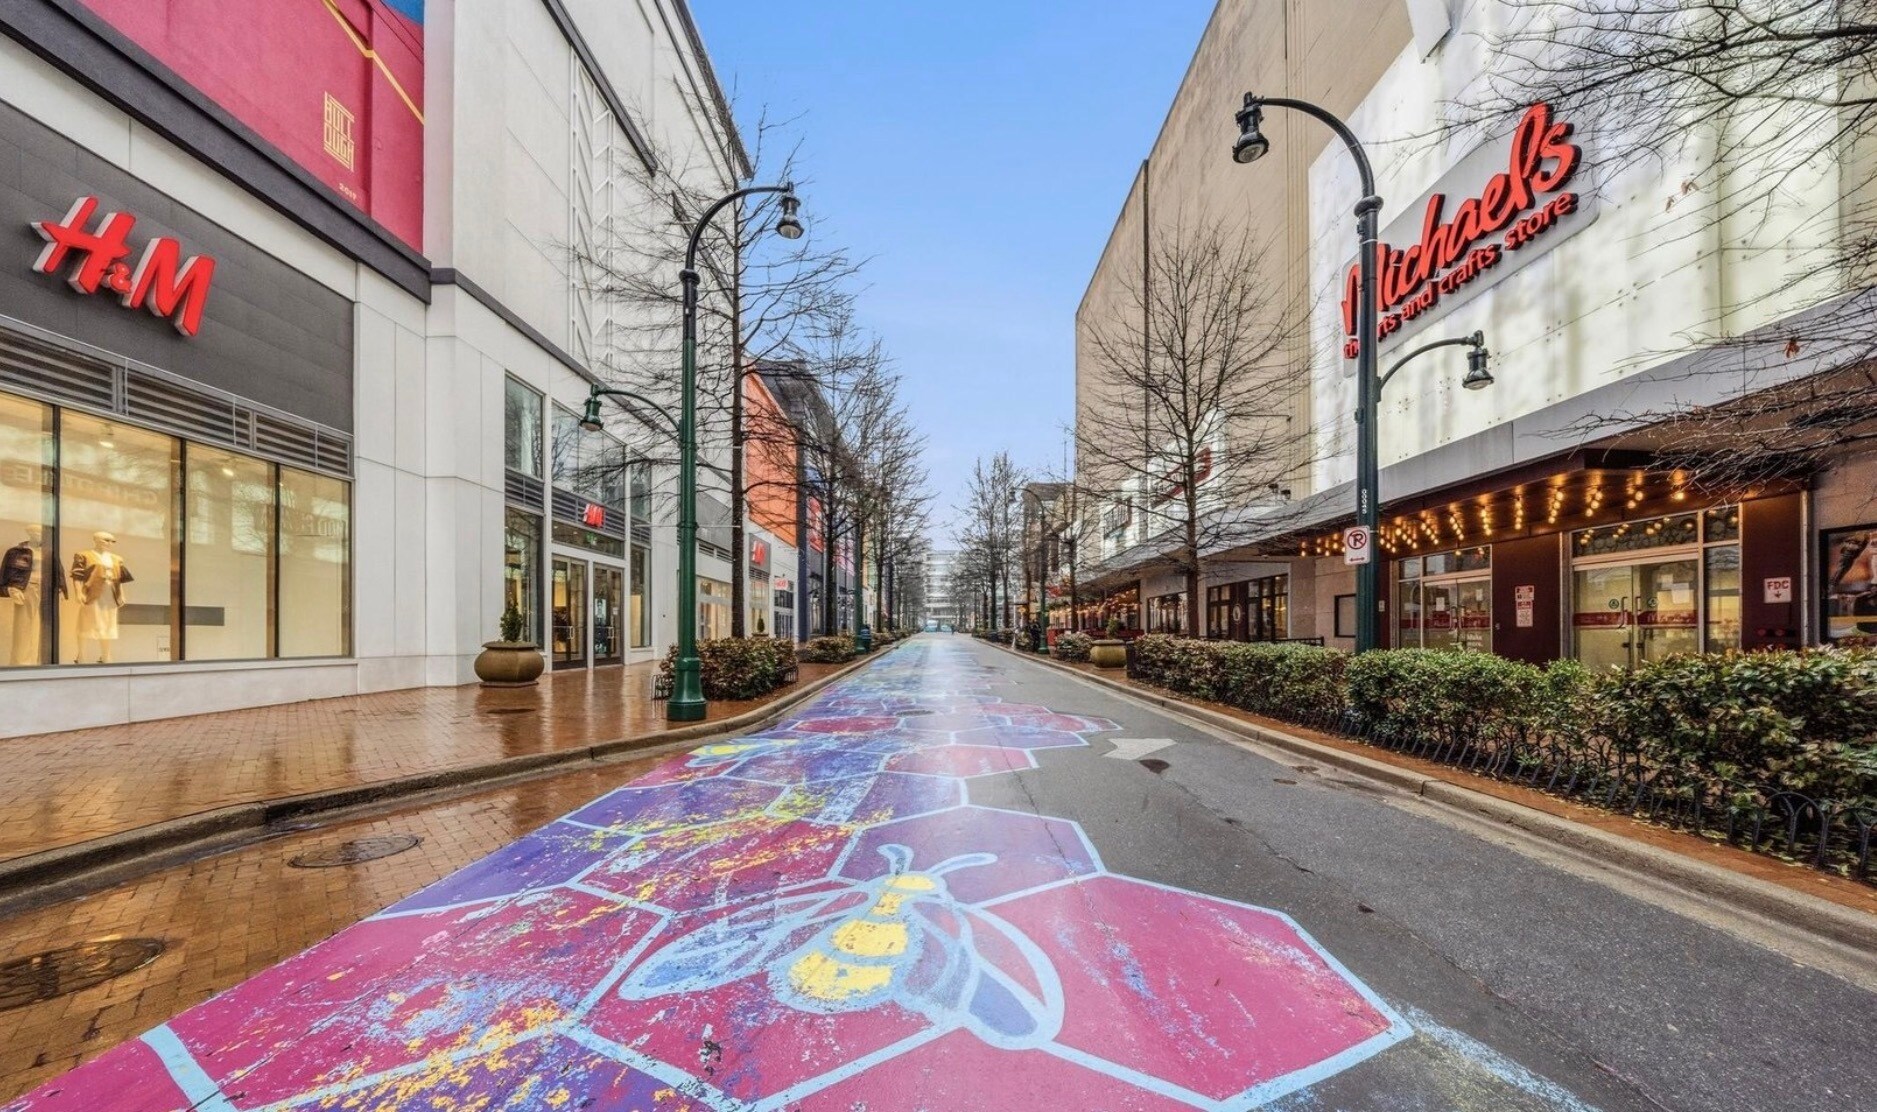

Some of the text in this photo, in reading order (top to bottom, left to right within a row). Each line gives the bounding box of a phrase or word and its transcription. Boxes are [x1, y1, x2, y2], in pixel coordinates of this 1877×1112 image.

[32, 196, 216, 336] H&M
[1344, 192, 1578, 360] th rts and crafts store
[1767, 580, 1789, 590] FDC
